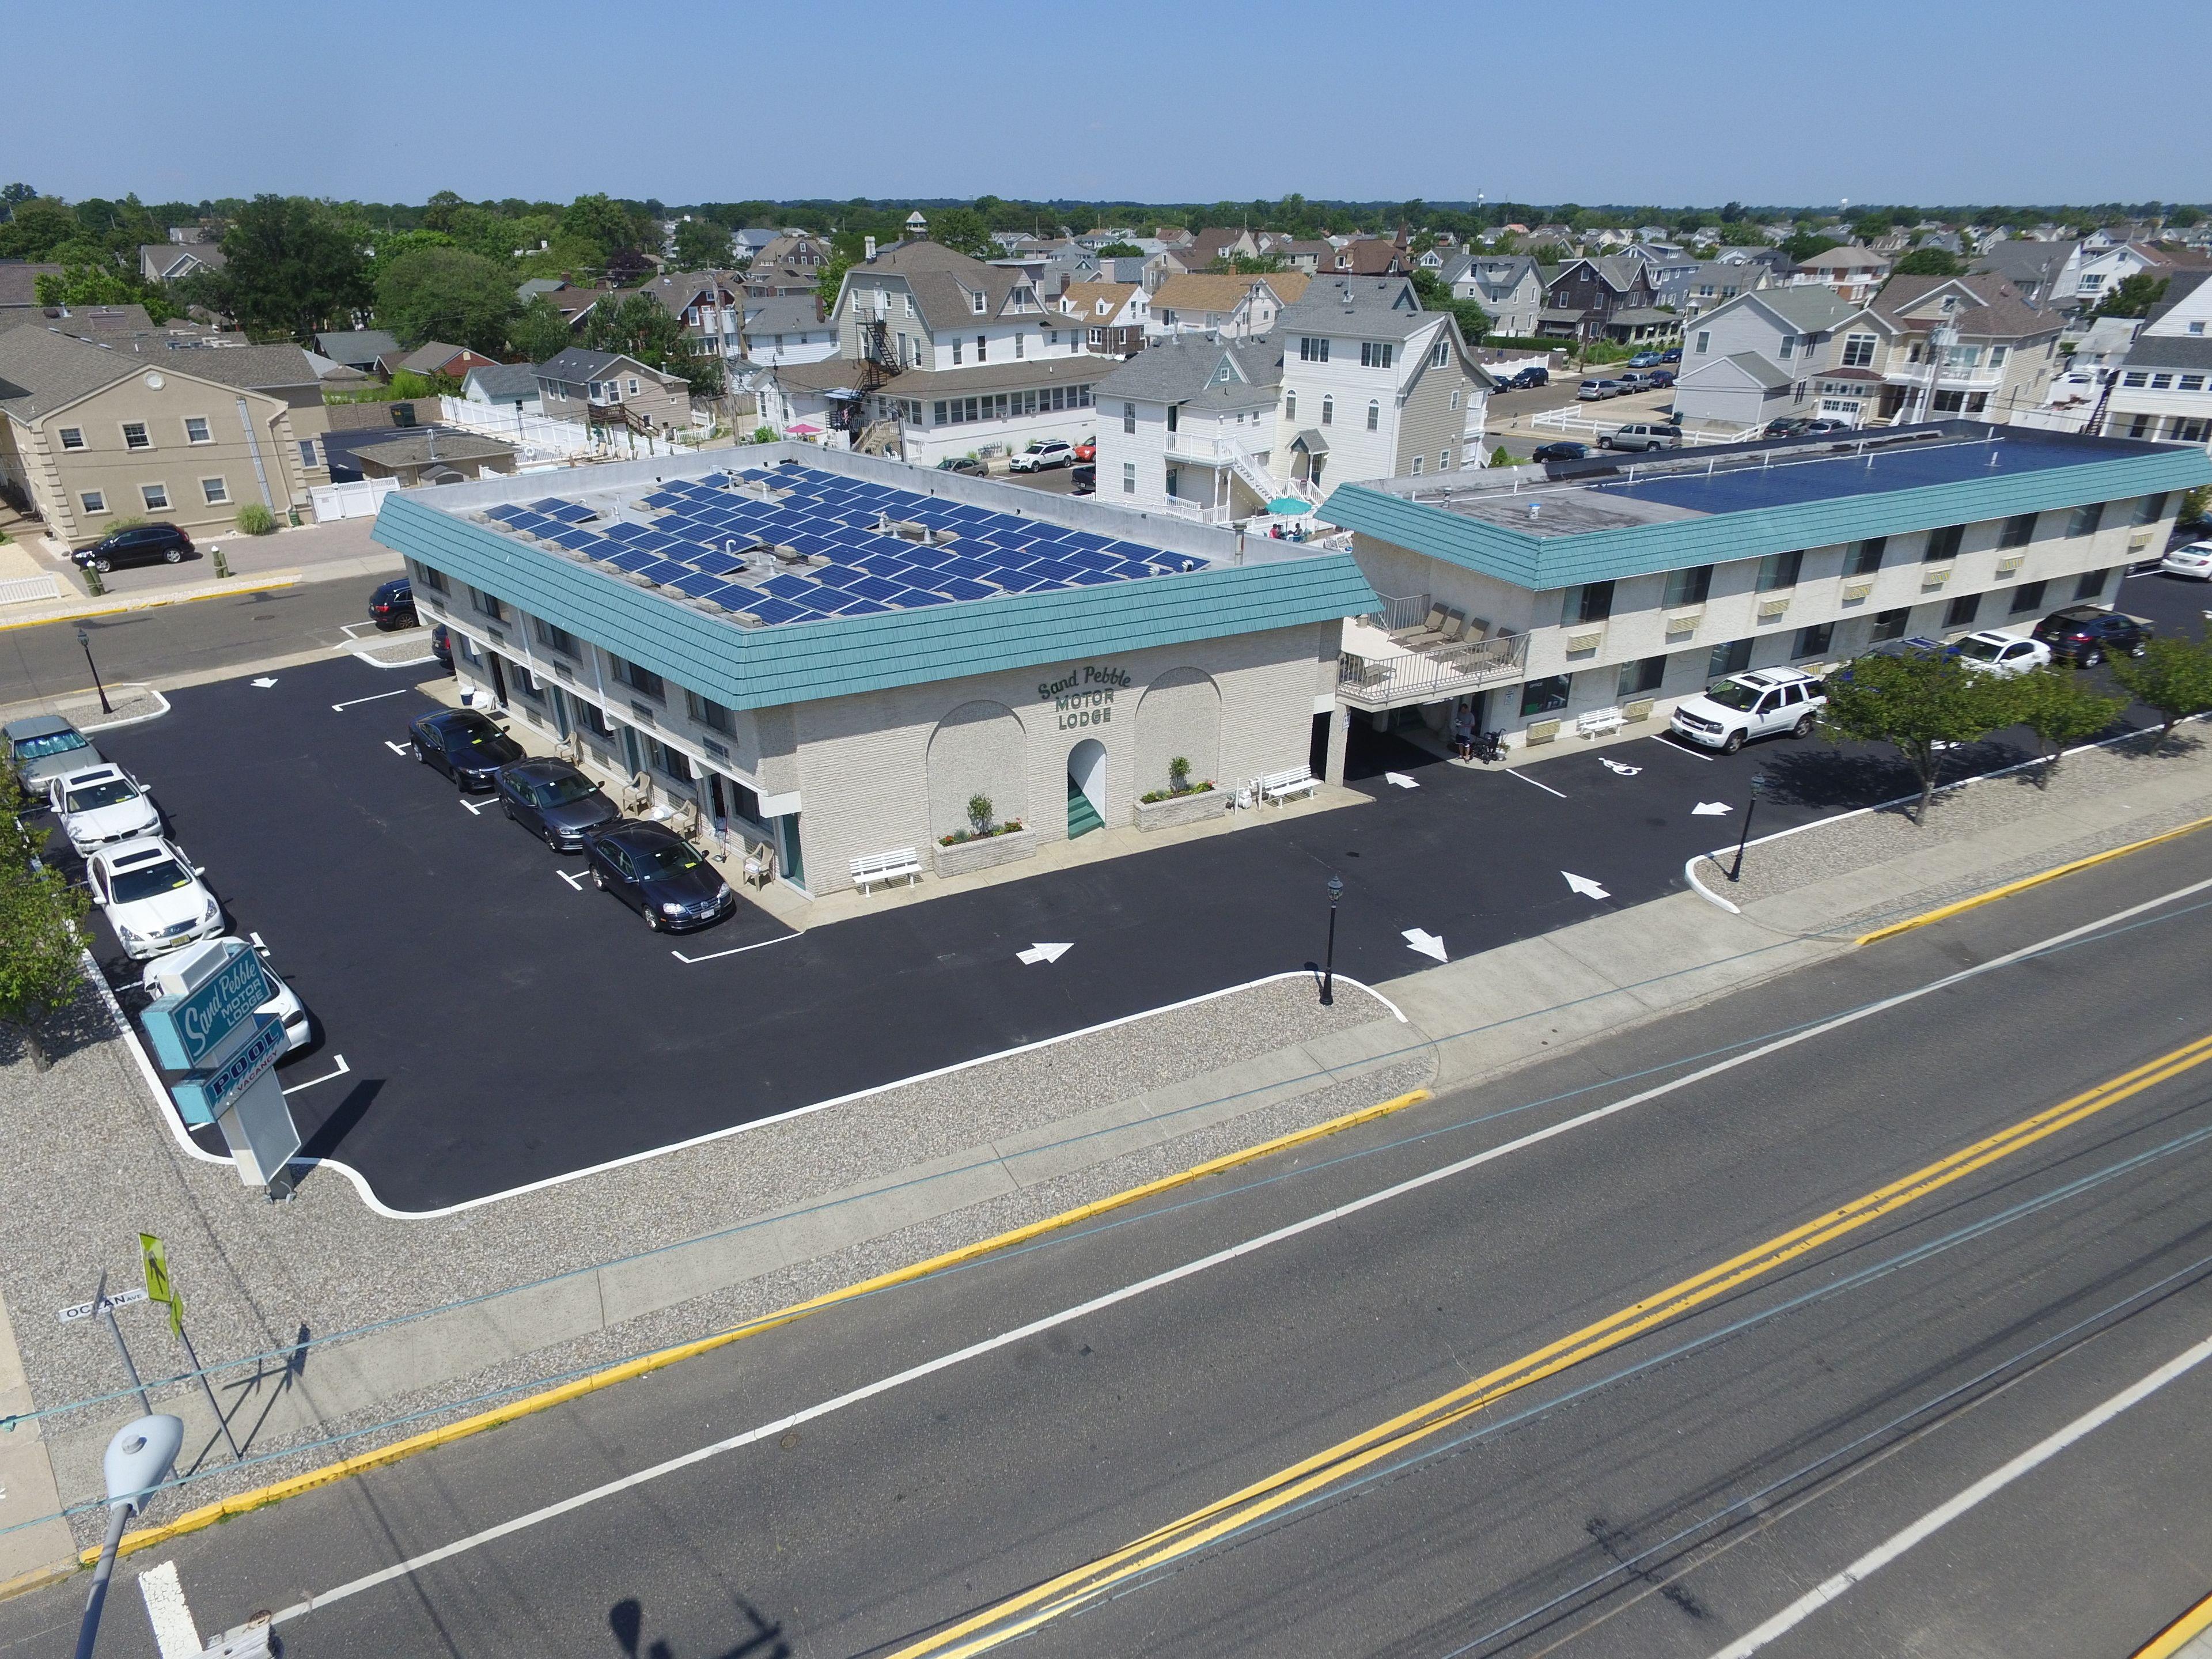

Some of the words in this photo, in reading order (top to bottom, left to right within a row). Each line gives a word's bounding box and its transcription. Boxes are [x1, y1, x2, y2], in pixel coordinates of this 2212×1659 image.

[1038, 670, 1079, 699] Sand
[1084, 666, 1131, 687] Pebble
[1056, 688, 1114, 712] MOTOR
[1059, 707, 1111, 730] LODGE
[185, 984, 222, 1056] Sand
[219, 960, 257, 1001] Pebble
[221, 978, 261, 1018] MOTOR
[227, 991, 263, 1027] LODGE
[211, 1029, 279, 1098] POOL
[237, 1050, 277, 1090] VACANCY
[67, 1296, 125, 1317] OCAN
